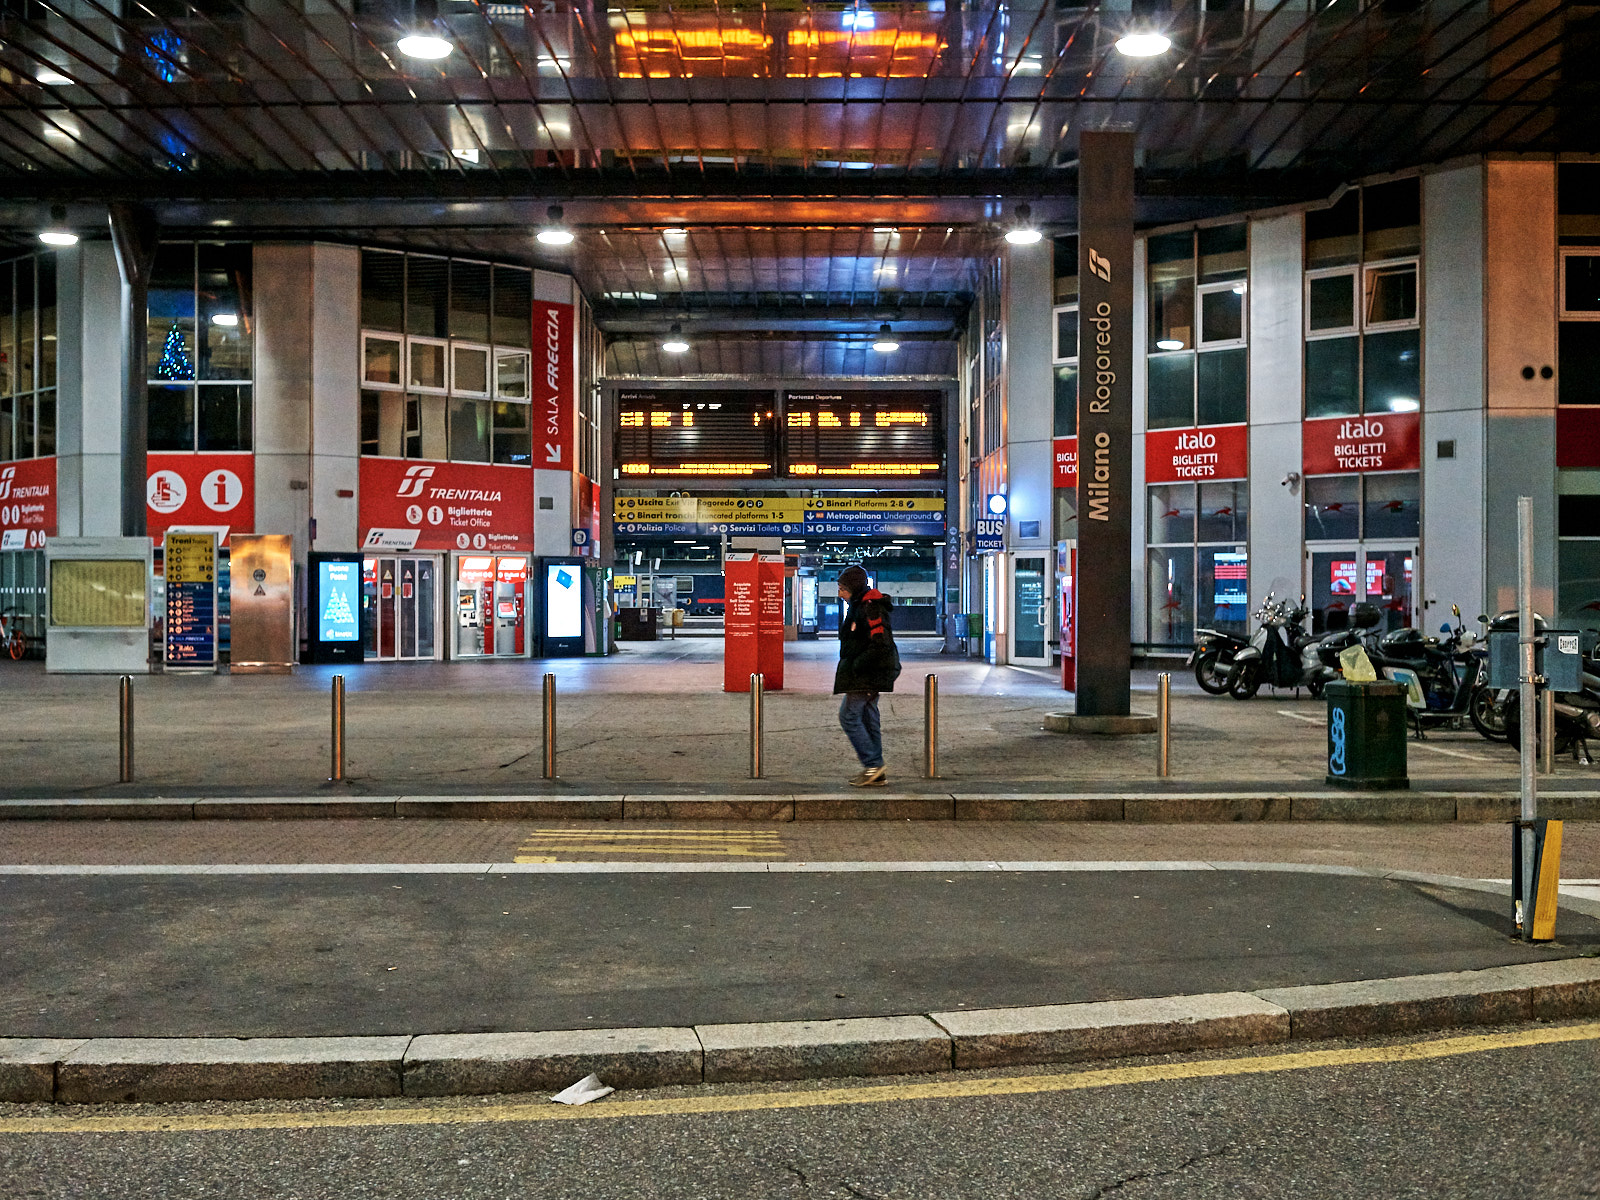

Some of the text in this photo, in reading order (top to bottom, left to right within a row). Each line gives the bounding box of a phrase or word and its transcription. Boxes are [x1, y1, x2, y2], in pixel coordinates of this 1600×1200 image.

[547, 309, 559, 435] SALA FRECCIA
[1088, 302, 1116, 522] Milano Rogoredo
[1334, 442, 1386, 456] BIGLIETTI
[1172, 453, 1218, 465] BIGLIETTI
[1337, 456, 1383, 468] TICKETS
[1175, 465, 1215, 477] TICKETS
[12, 485, 49, 499] TRENITALIA
[429, 488, 502, 502] TRENITALIA
[697, 498, 735, 508] Rogoredo
[448, 507, 493, 517] Biglietteria
[735, 512, 769, 520] platforms
[826, 512, 882, 521] Metropolitana
[883, 512, 932, 521] Underground
[450, 517, 491, 528] Ticket Office
[636, 524, 686, 532] Polizia Police
[729, 524, 780, 532] Servizi Toilets
[976, 521, 1003, 536] BUS
[488, 533, 519, 541] Biglietteria
